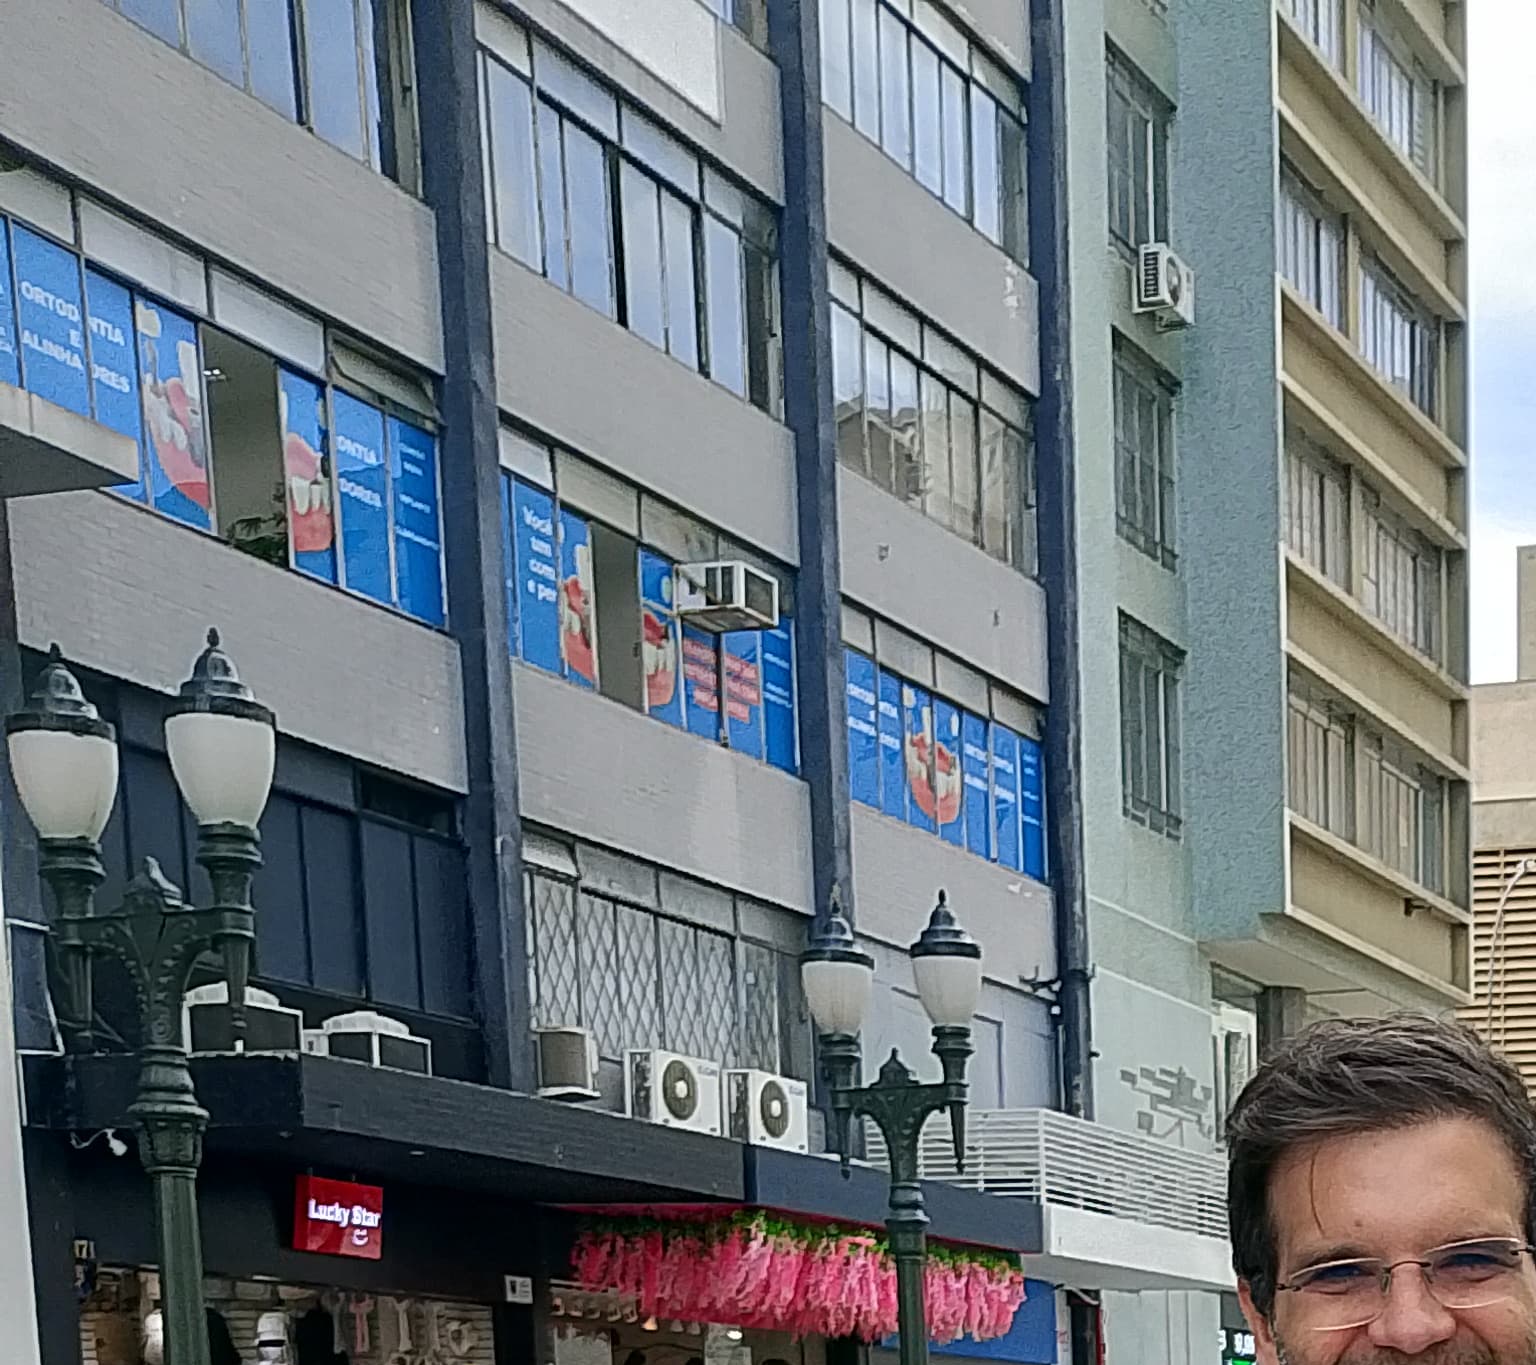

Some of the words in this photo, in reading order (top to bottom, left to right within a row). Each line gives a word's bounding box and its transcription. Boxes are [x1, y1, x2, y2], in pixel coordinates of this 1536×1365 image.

[20, 280, 126, 347] ORTODNTIA
[308, 1198, 350, 1227] Lucky
[351, 1205, 381, 1227] Star
